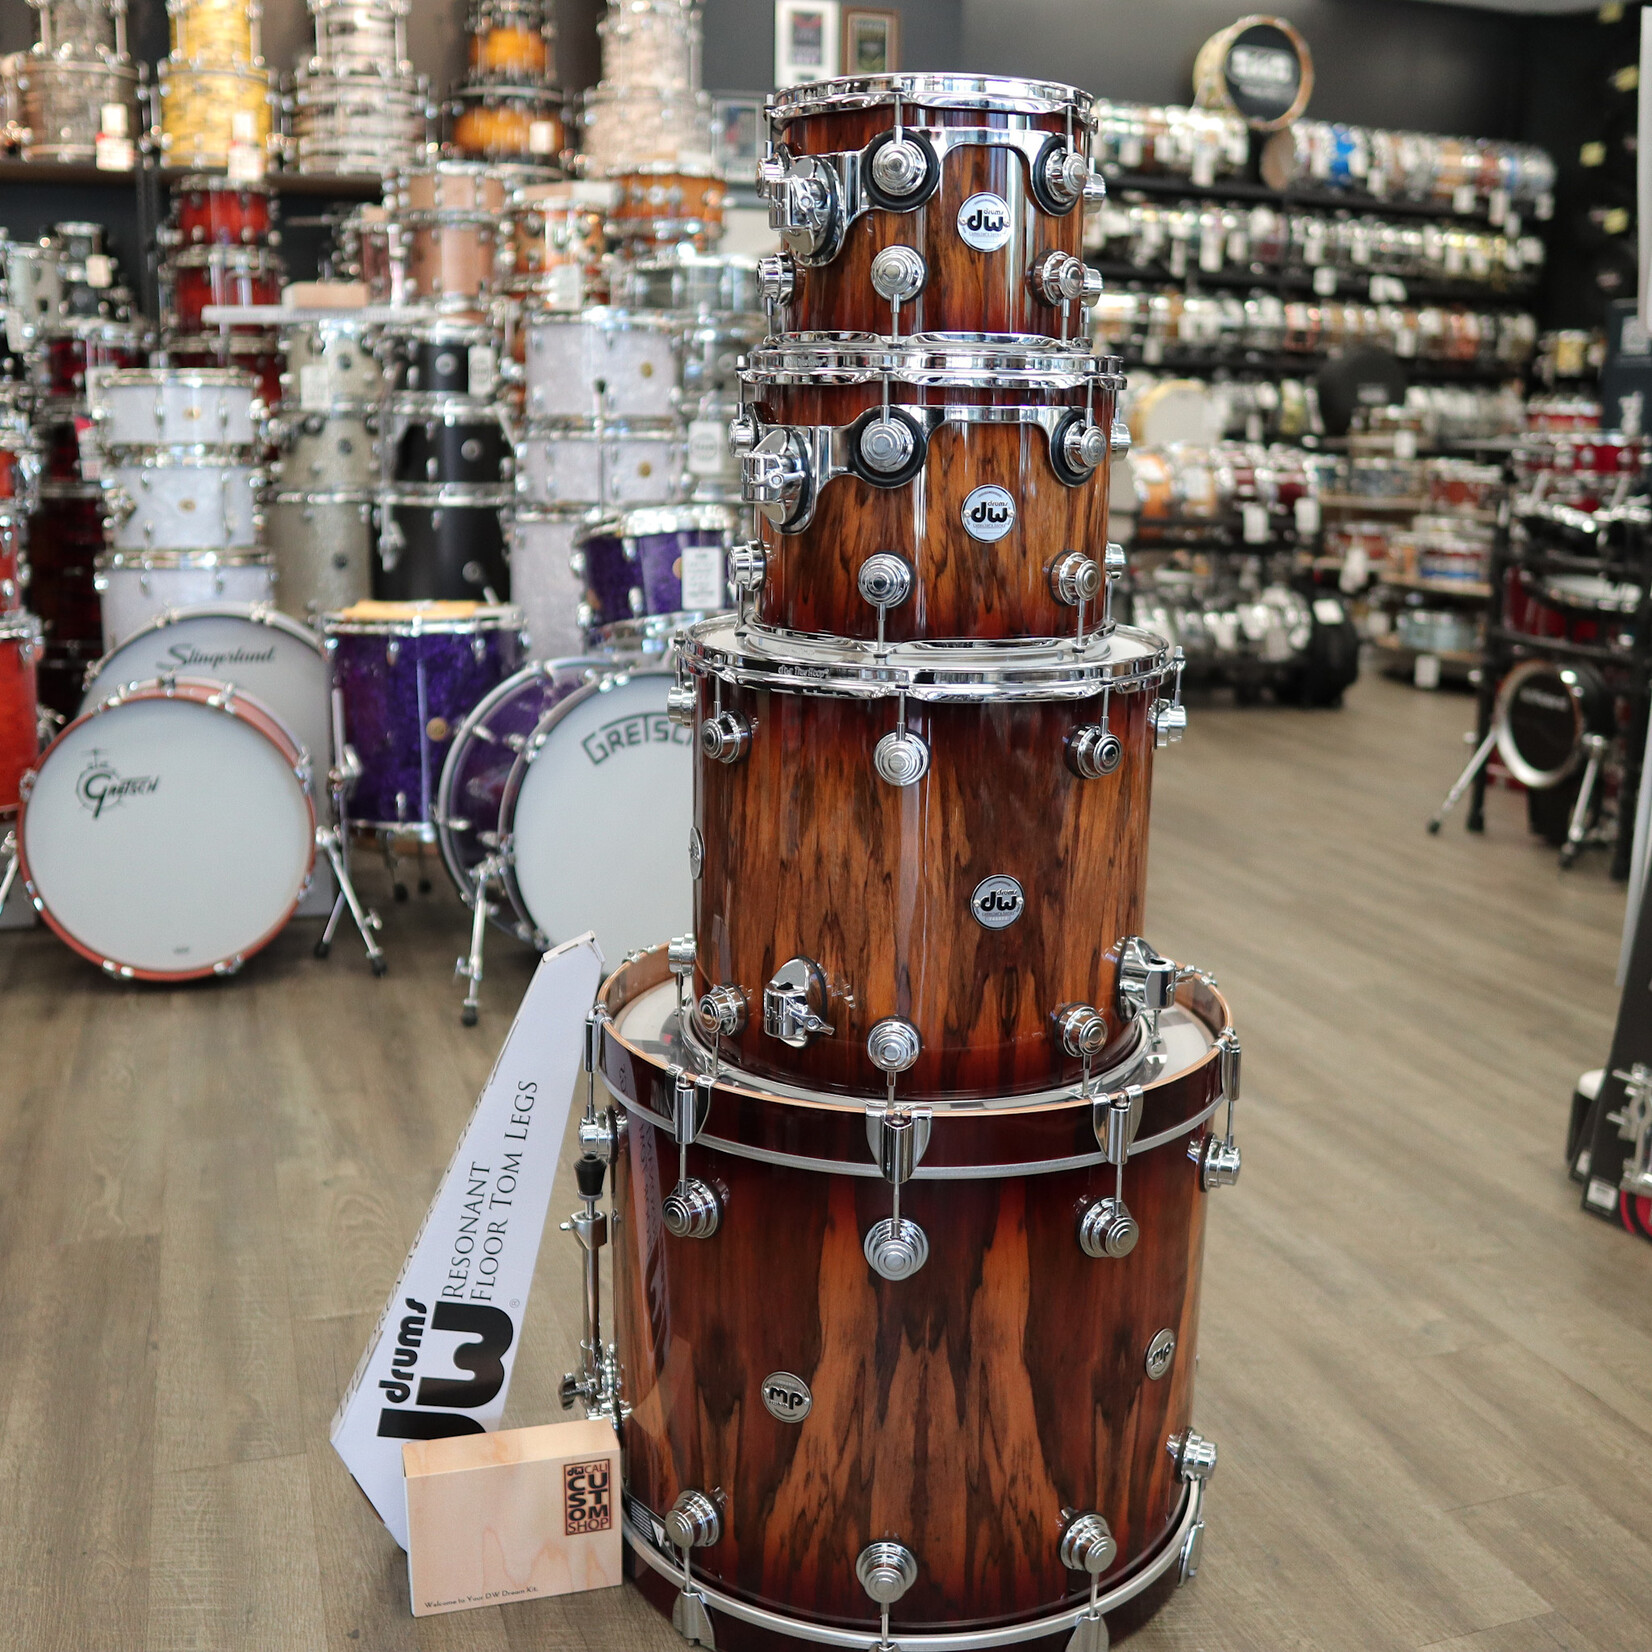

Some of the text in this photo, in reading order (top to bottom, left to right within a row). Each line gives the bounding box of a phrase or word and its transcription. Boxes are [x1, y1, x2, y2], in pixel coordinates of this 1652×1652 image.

[967, 209, 1004, 232] dw
[970, 501, 1008, 523] dw
[155, 643, 275, 671] Slingerland
[980, 890, 1017, 912] dw
[469, 1080, 538, 1302] FLOOR TOM LEGS
[441, 1160, 491, 1300] RESONANT
[378, 1297, 427, 1404] drums
[584, 1462, 608, 1474] CALI
[567, 1517, 609, 1534] SHOP
[466, 1595, 484, 1603] Your
[501, 1588, 526, 1597] Dream
